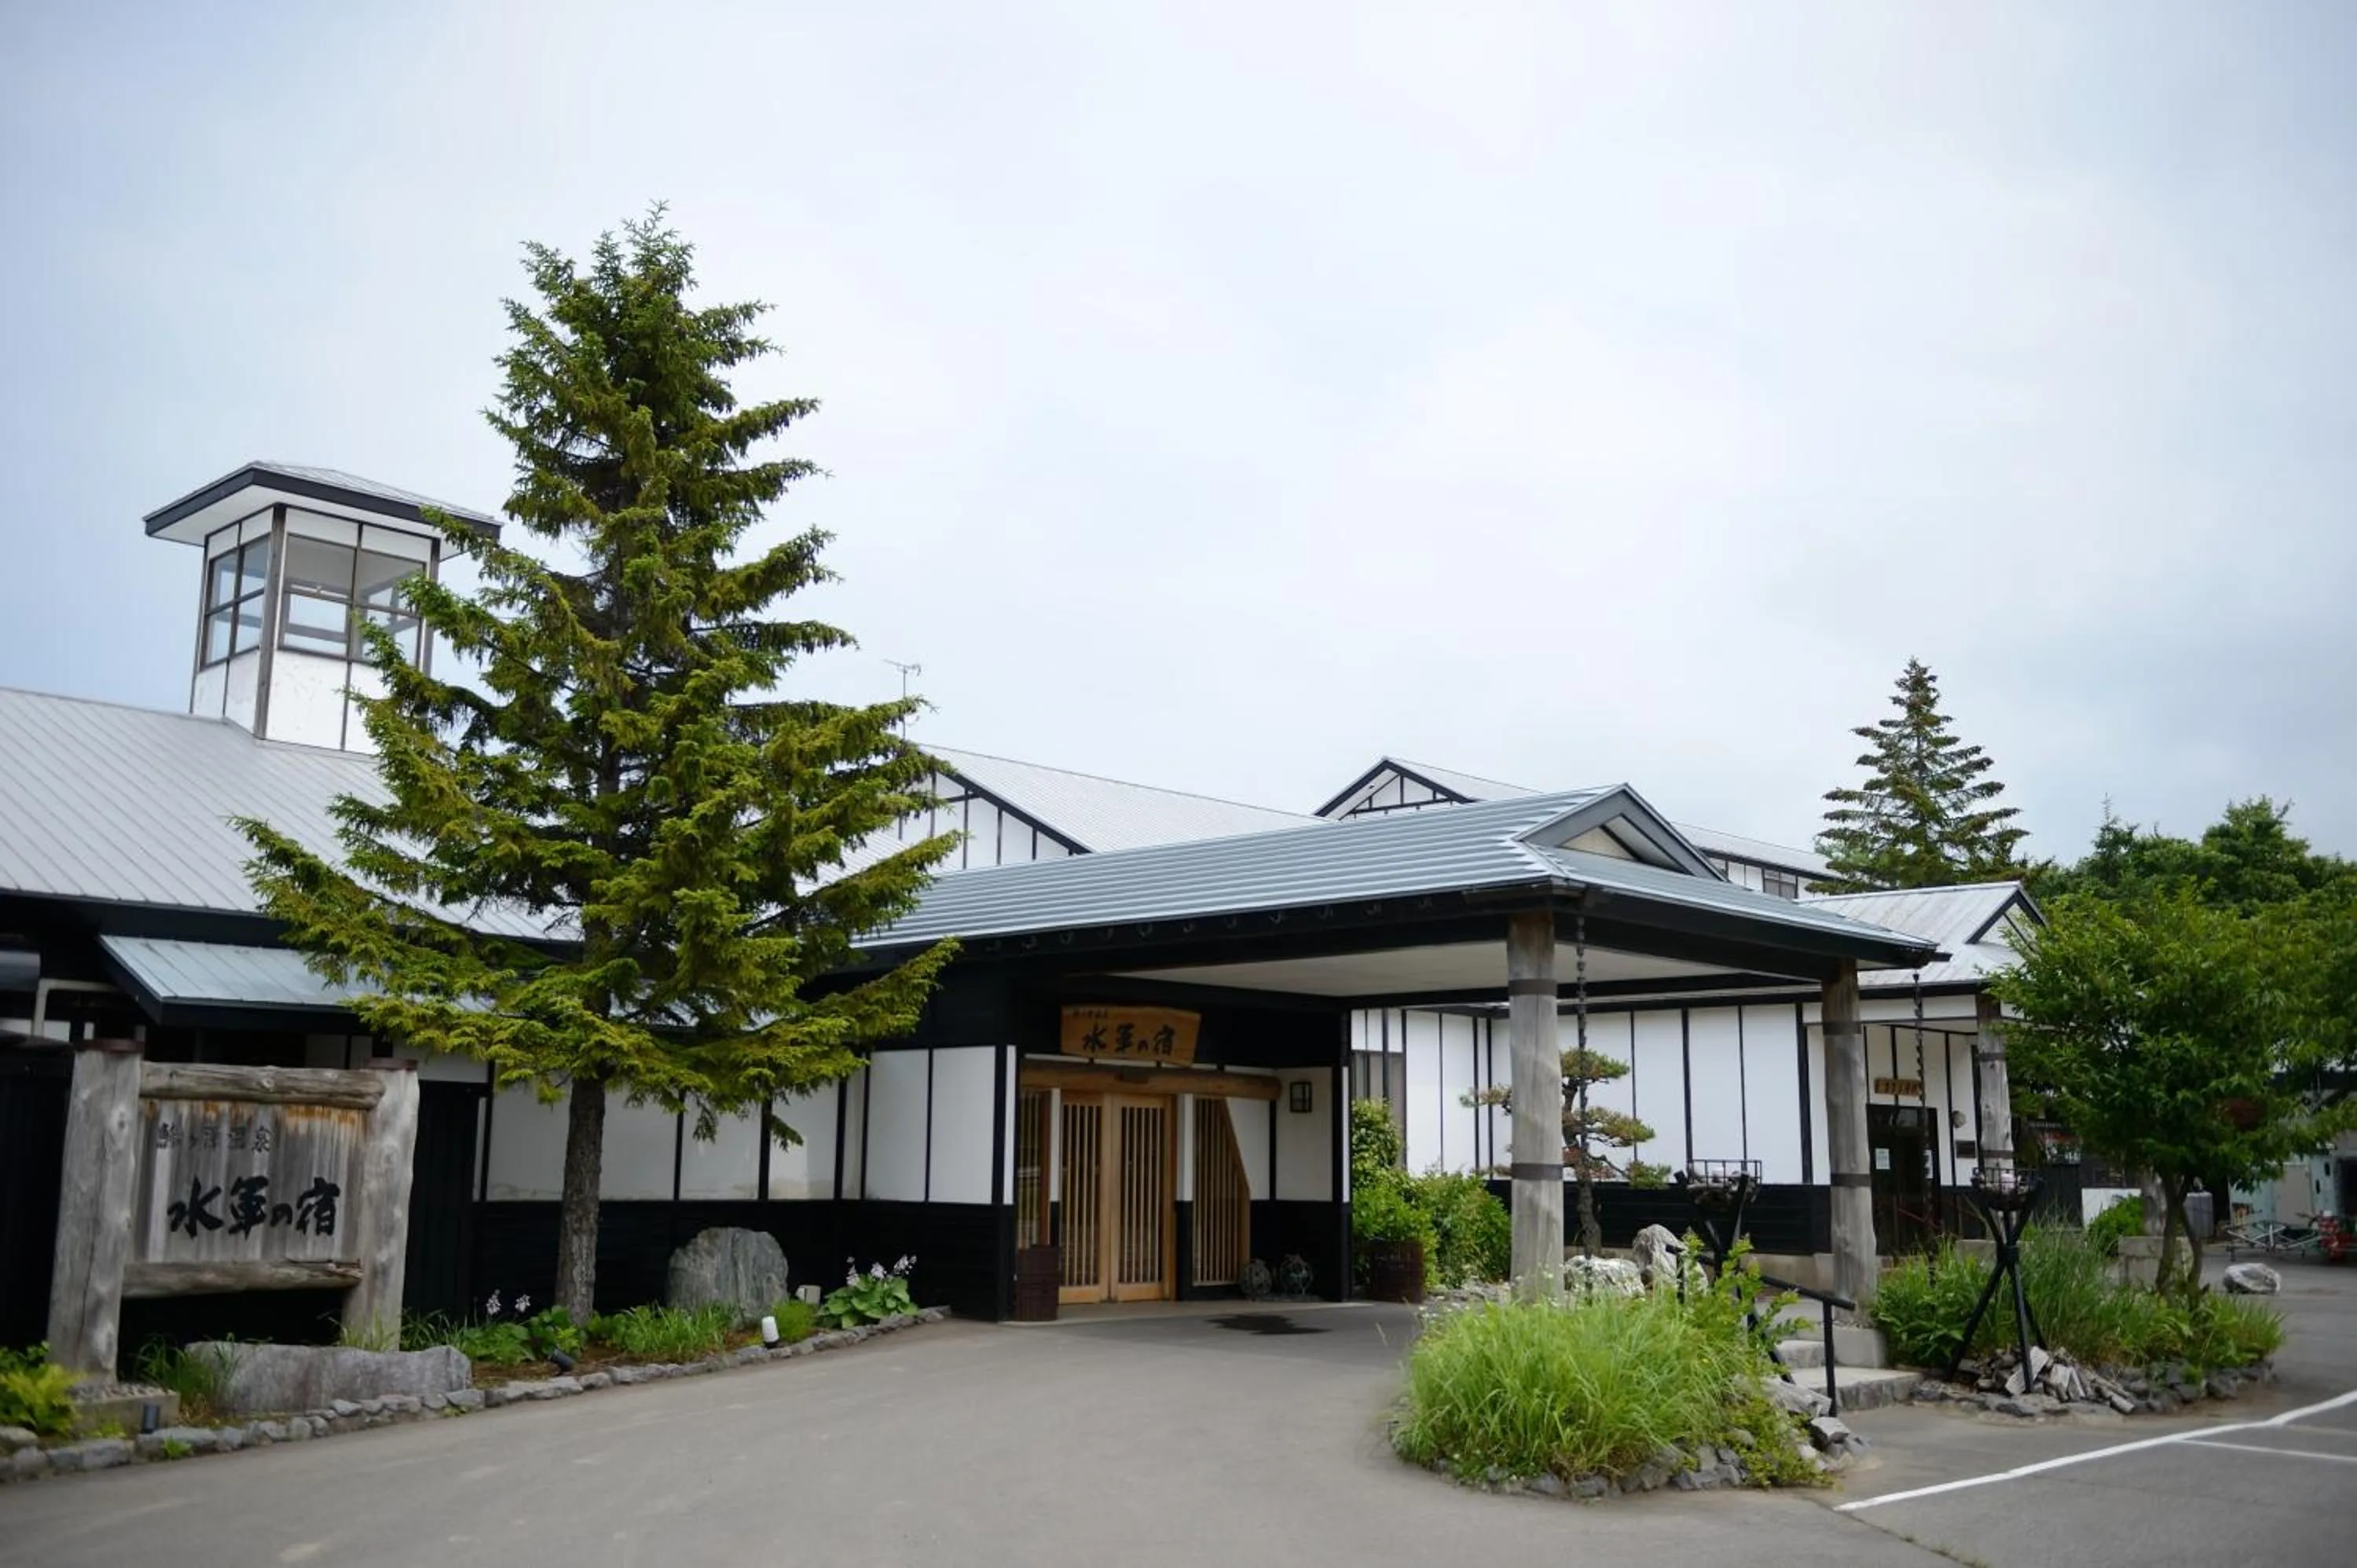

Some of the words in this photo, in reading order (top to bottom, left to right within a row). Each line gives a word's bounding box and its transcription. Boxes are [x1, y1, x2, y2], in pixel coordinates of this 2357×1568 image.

[1083, 1021, 1175, 1057] 水軍の宿
[167, 1175, 340, 1240] 水軍の宿
